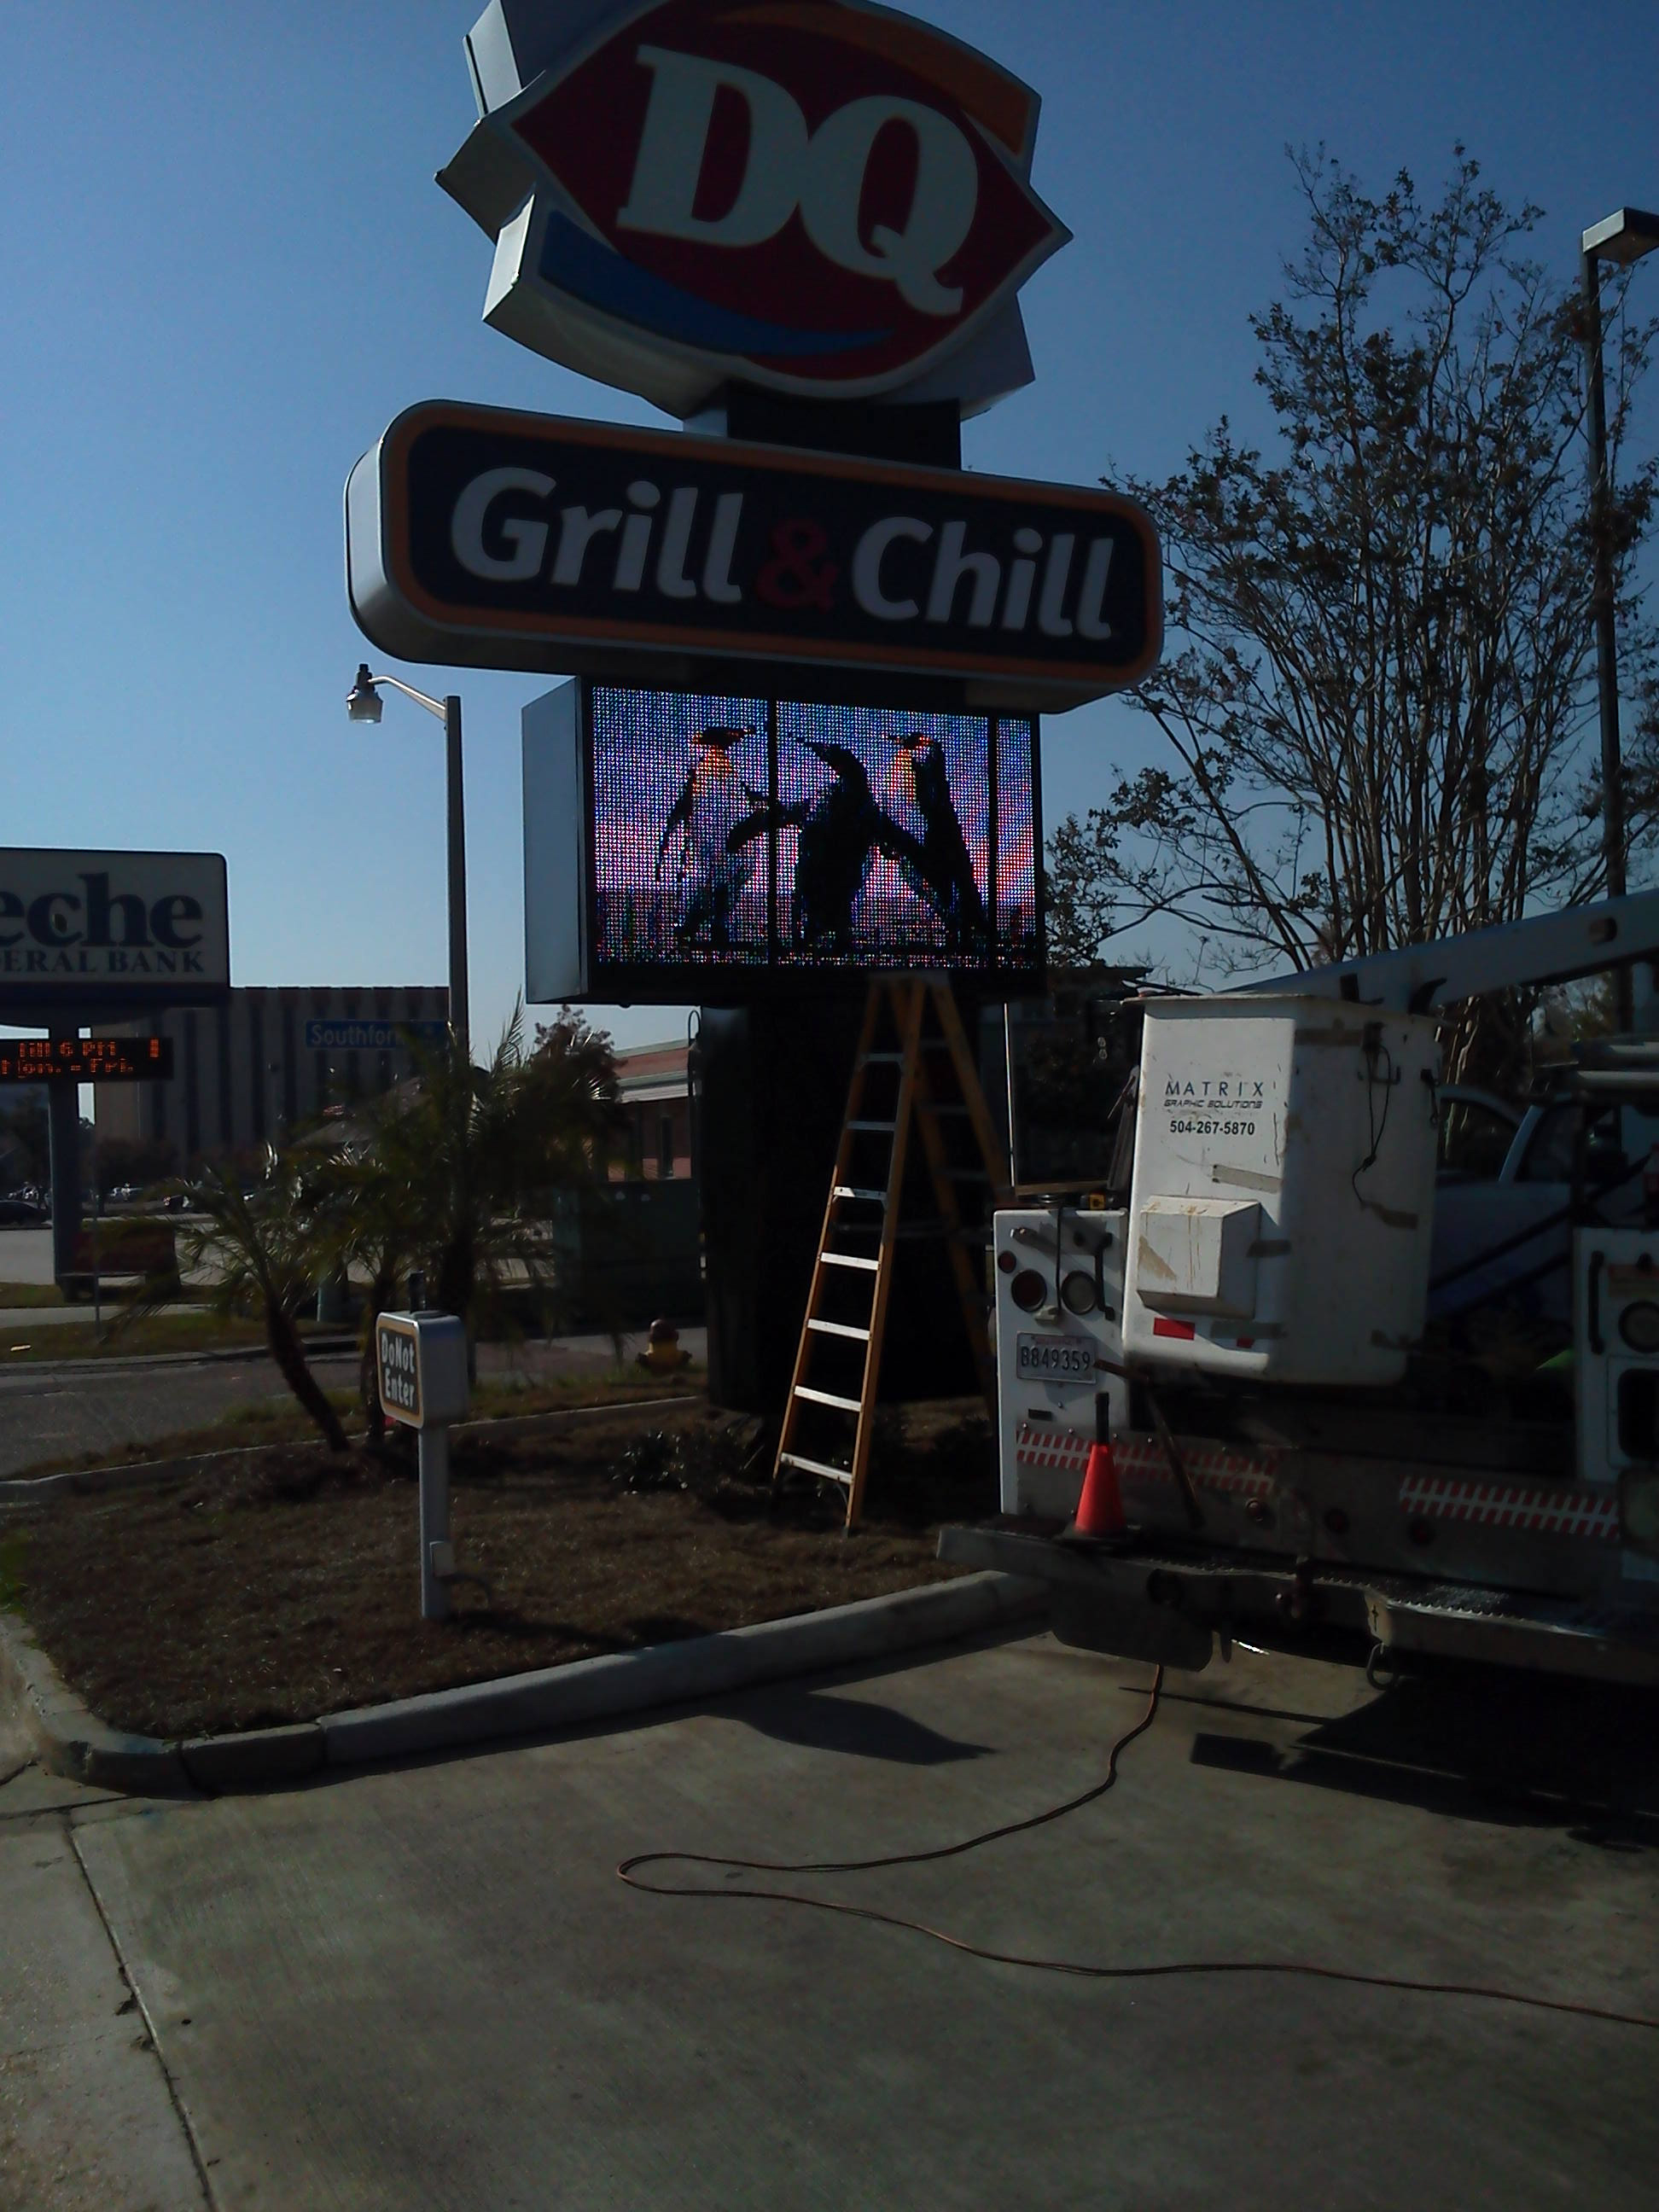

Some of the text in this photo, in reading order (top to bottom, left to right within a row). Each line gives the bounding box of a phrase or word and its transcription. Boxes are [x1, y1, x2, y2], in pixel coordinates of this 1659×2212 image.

[615, 44, 978, 316] DQ
[451, 467, 1114, 641] Grill & Chill
[108, 950, 205, 973] BANK
[1165, 1080, 1264, 1097] MATRIX
[1164, 1099, 1263, 1109] GRAPHIC SOLUTIONS
[1169, 1121, 1255, 1135] 504-267-5870
[1021, 1346, 1091, 1371] B849359
[384, 1368, 416, 1407] Enter
